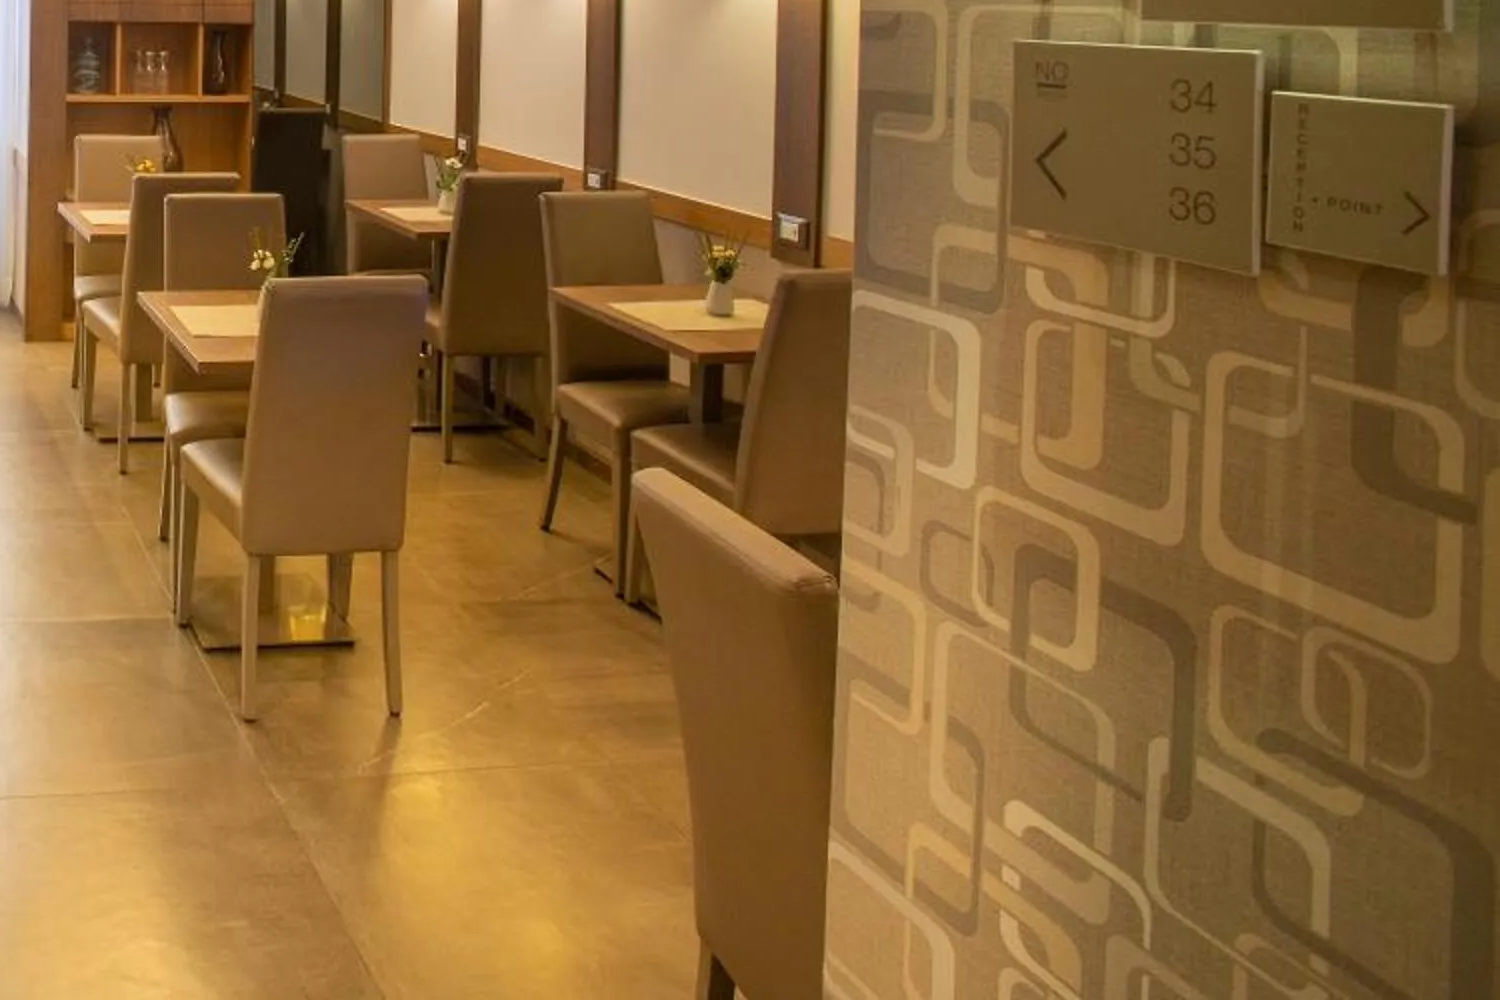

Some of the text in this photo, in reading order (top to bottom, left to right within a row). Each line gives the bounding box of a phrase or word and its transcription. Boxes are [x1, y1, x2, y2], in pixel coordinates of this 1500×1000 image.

[1169, 78, 1218, 114] 34
[1168, 132, 1218, 170] 35
[1168, 186, 1217, 226] 36
